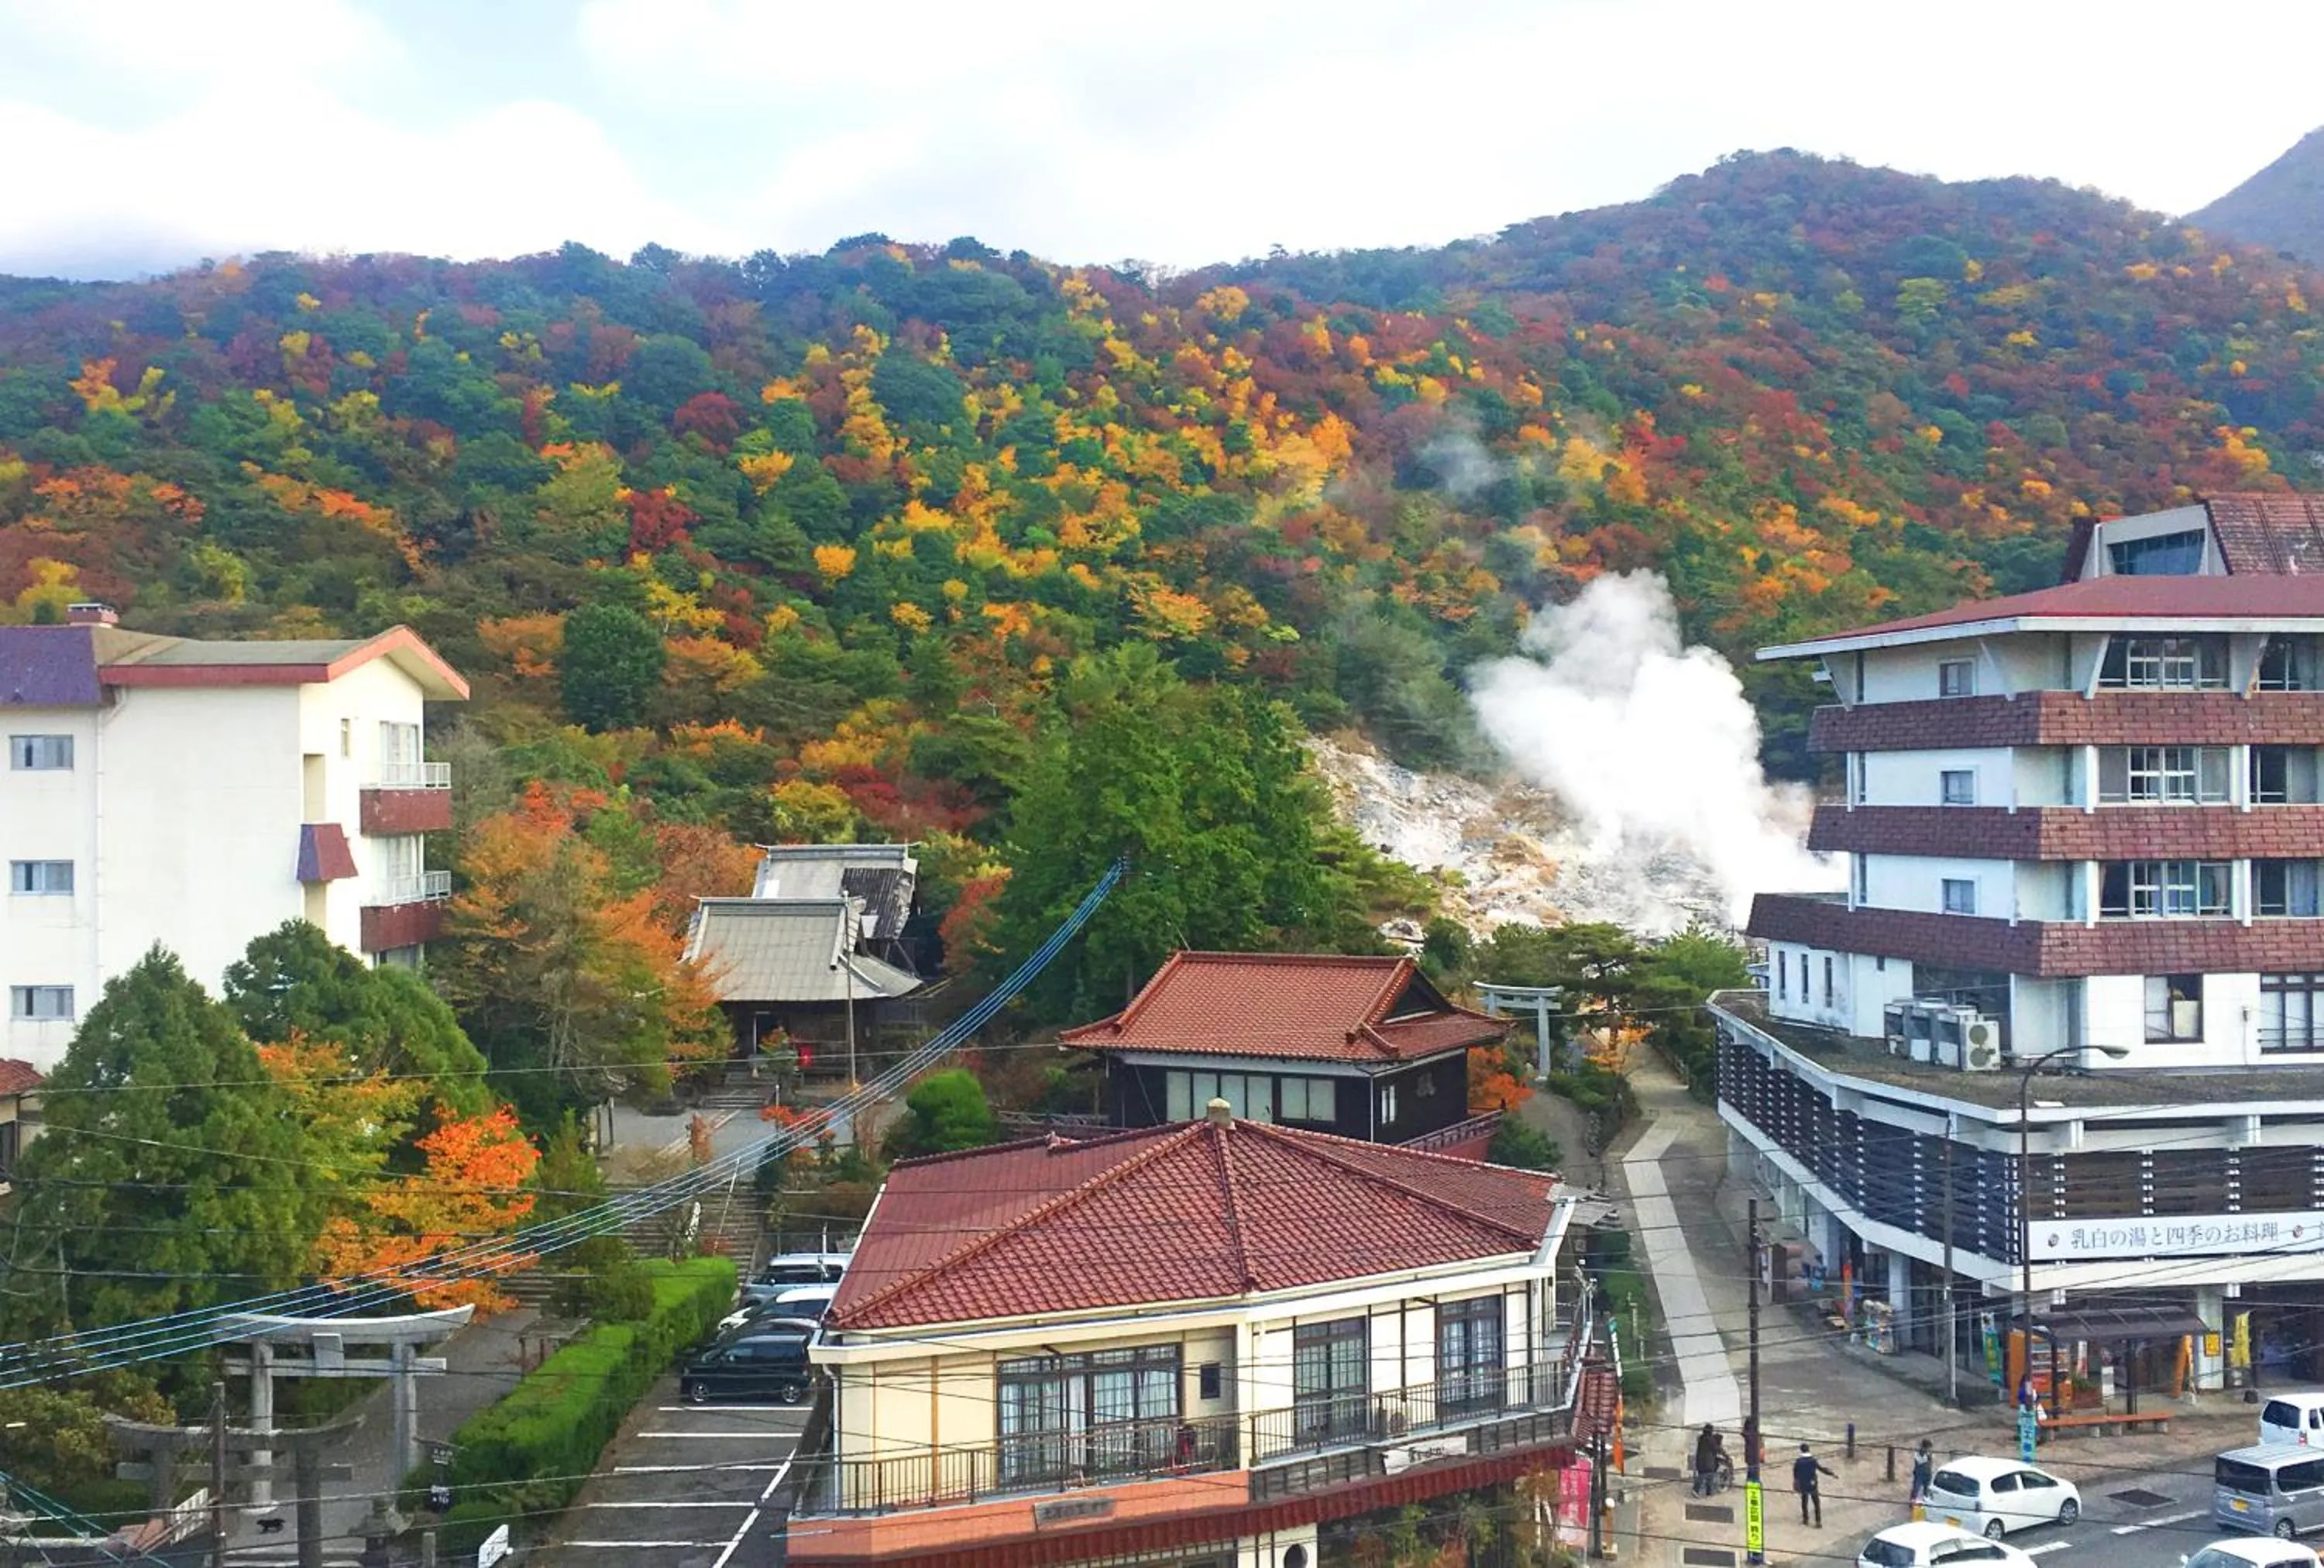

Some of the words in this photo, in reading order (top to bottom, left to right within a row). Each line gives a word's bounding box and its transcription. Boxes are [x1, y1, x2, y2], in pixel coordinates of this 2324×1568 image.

[2071, 1222, 2278, 1249] 乳白の湯と四季のお料理
